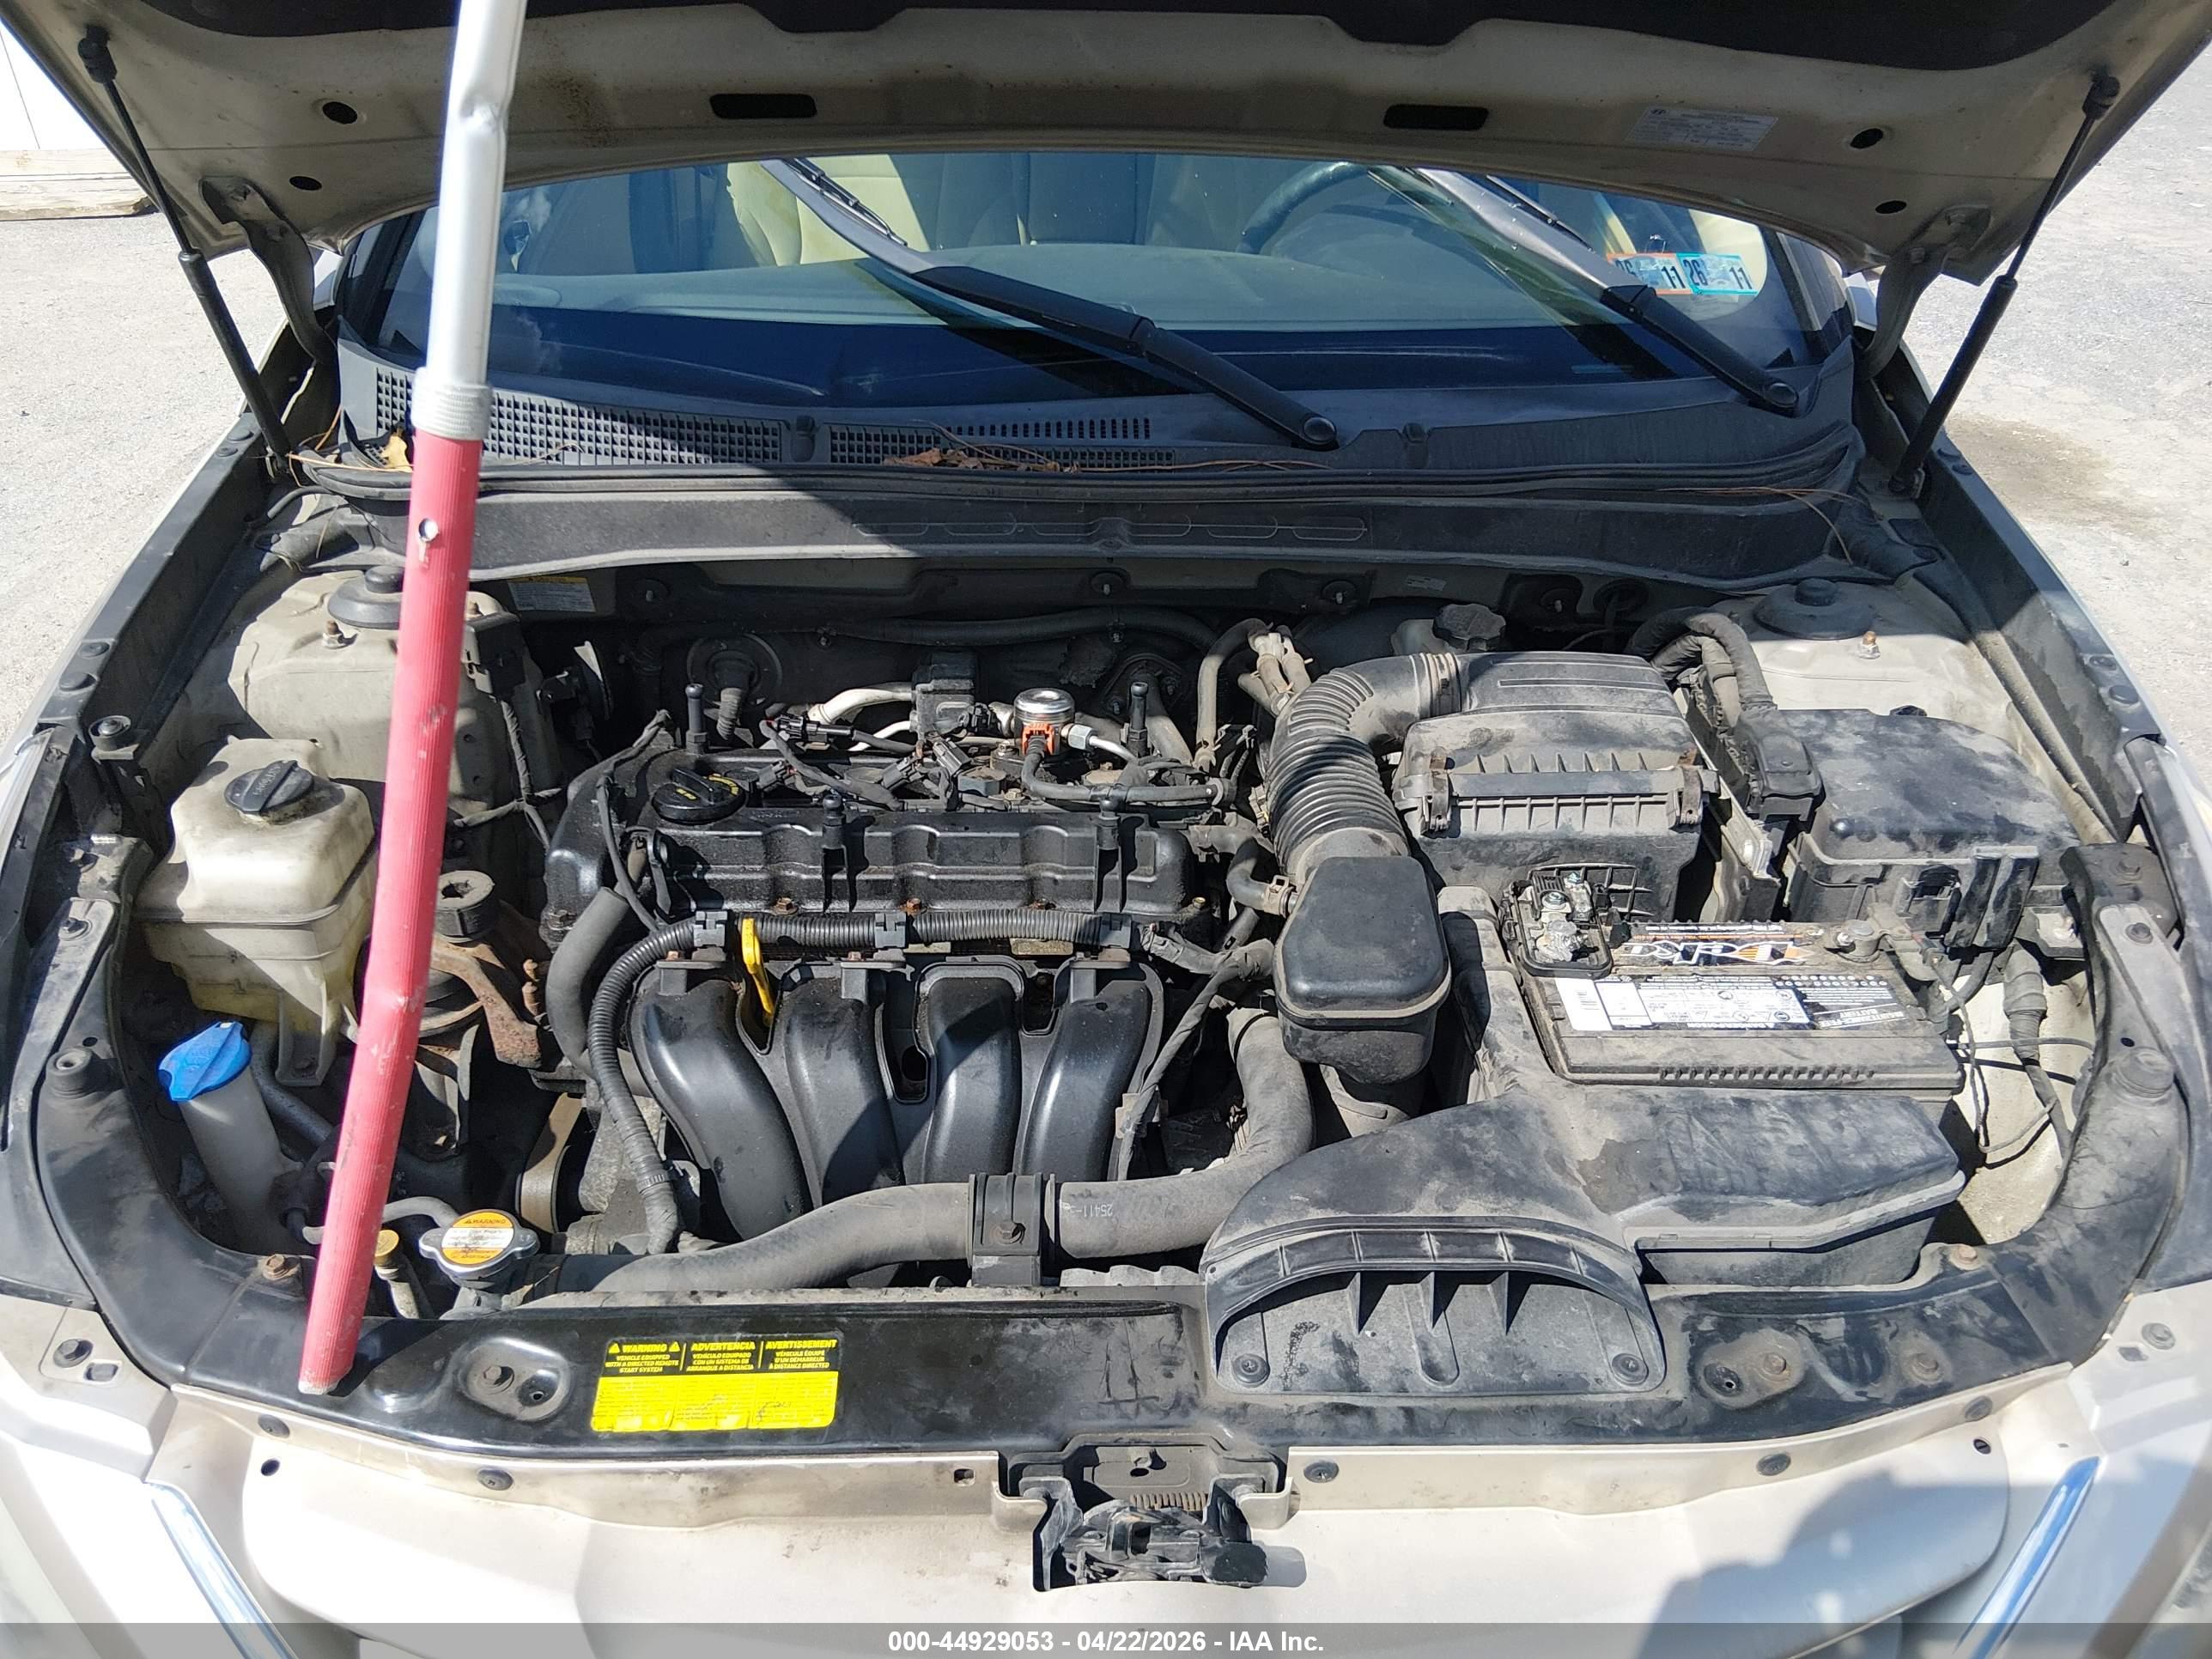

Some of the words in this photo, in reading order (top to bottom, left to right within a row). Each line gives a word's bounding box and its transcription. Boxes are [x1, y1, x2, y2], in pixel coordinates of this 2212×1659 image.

[1662, 266, 1686, 289] 11
[1684, 259, 1708, 285] 26
[1729, 266, 1753, 290] 11
[622, 1343, 667, 1353] WARNING
[691, 1341, 756, 1352] ADVERTENCIA
[765, 1339, 837, 1349] AVERTISSEMENT
